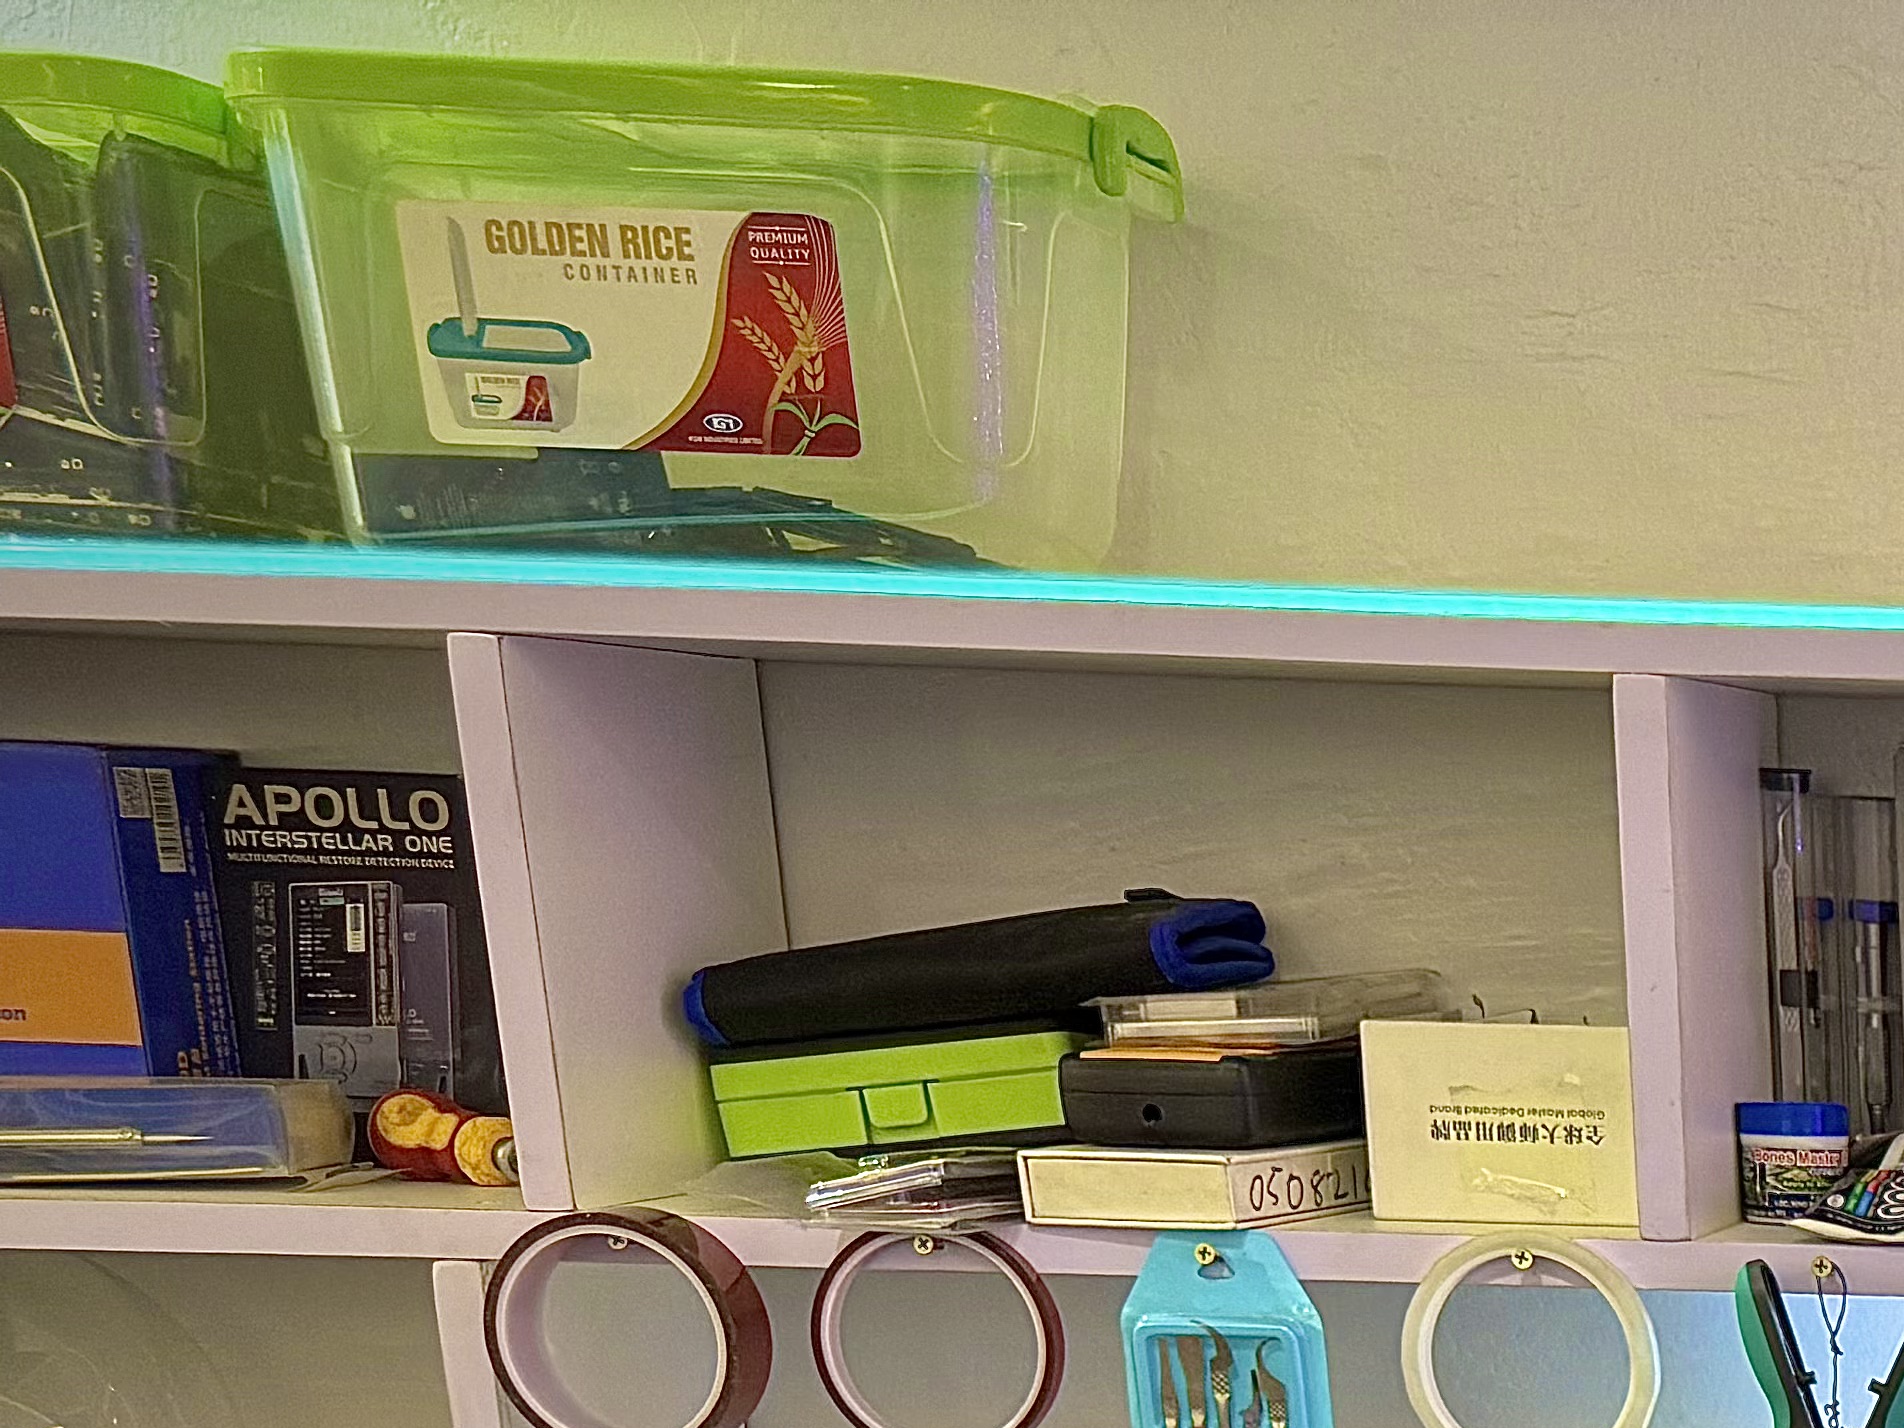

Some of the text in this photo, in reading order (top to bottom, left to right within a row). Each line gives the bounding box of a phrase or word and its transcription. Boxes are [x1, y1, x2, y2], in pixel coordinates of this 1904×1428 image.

[484, 218, 695, 262] GOLDEN RICE
[748, 230, 808, 245] PREMIUM
[750, 247, 811, 261] QUALITY
[563, 263, 698, 286] CONTAINER
[223, 783, 450, 831] APOLLO
[223, 829, 454, 854] INTERSTELLAR ONE
[1430, 1105, 1605, 1120] Global Master Dedicated Brand
